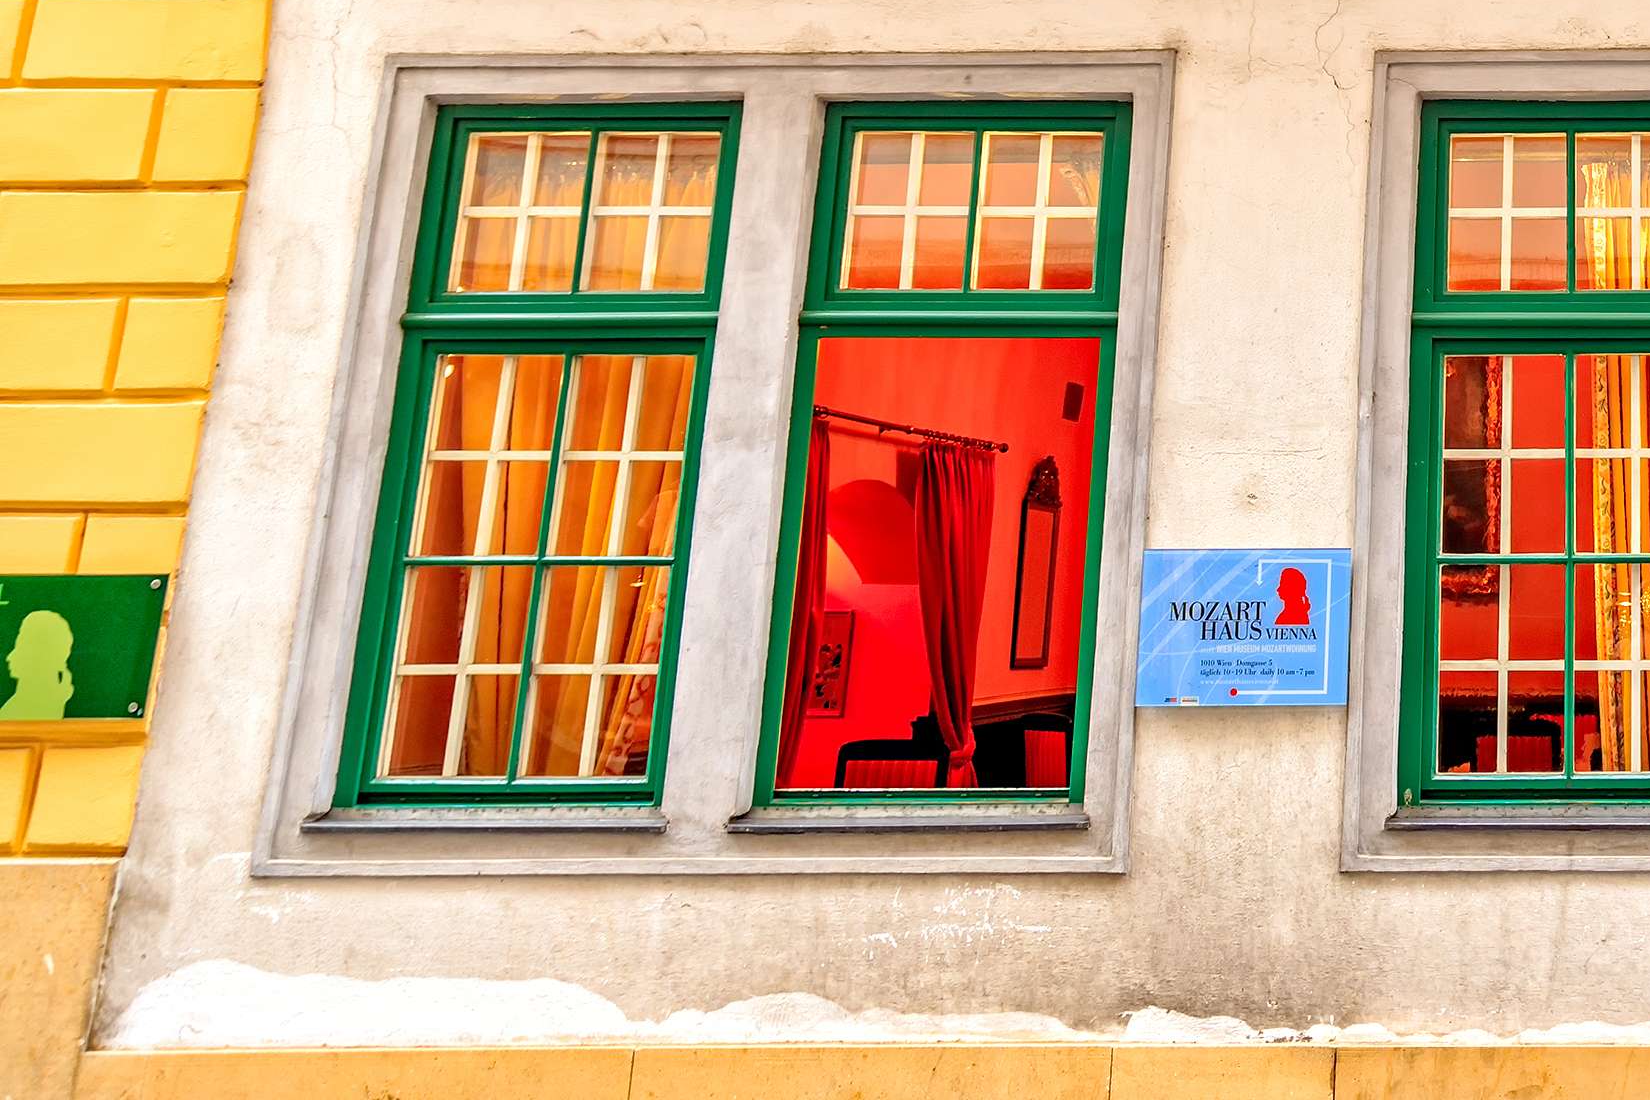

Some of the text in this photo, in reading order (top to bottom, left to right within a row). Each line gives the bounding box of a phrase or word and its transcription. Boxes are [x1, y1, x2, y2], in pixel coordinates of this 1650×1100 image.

[1168, 601, 1267, 622] MOZART
[1200, 620, 1318, 641] HAUS VIENNA
[1200, 658, 1273, 668] 1010 Wien Domgasse 5
[1260, 668, 1275, 677] daily
